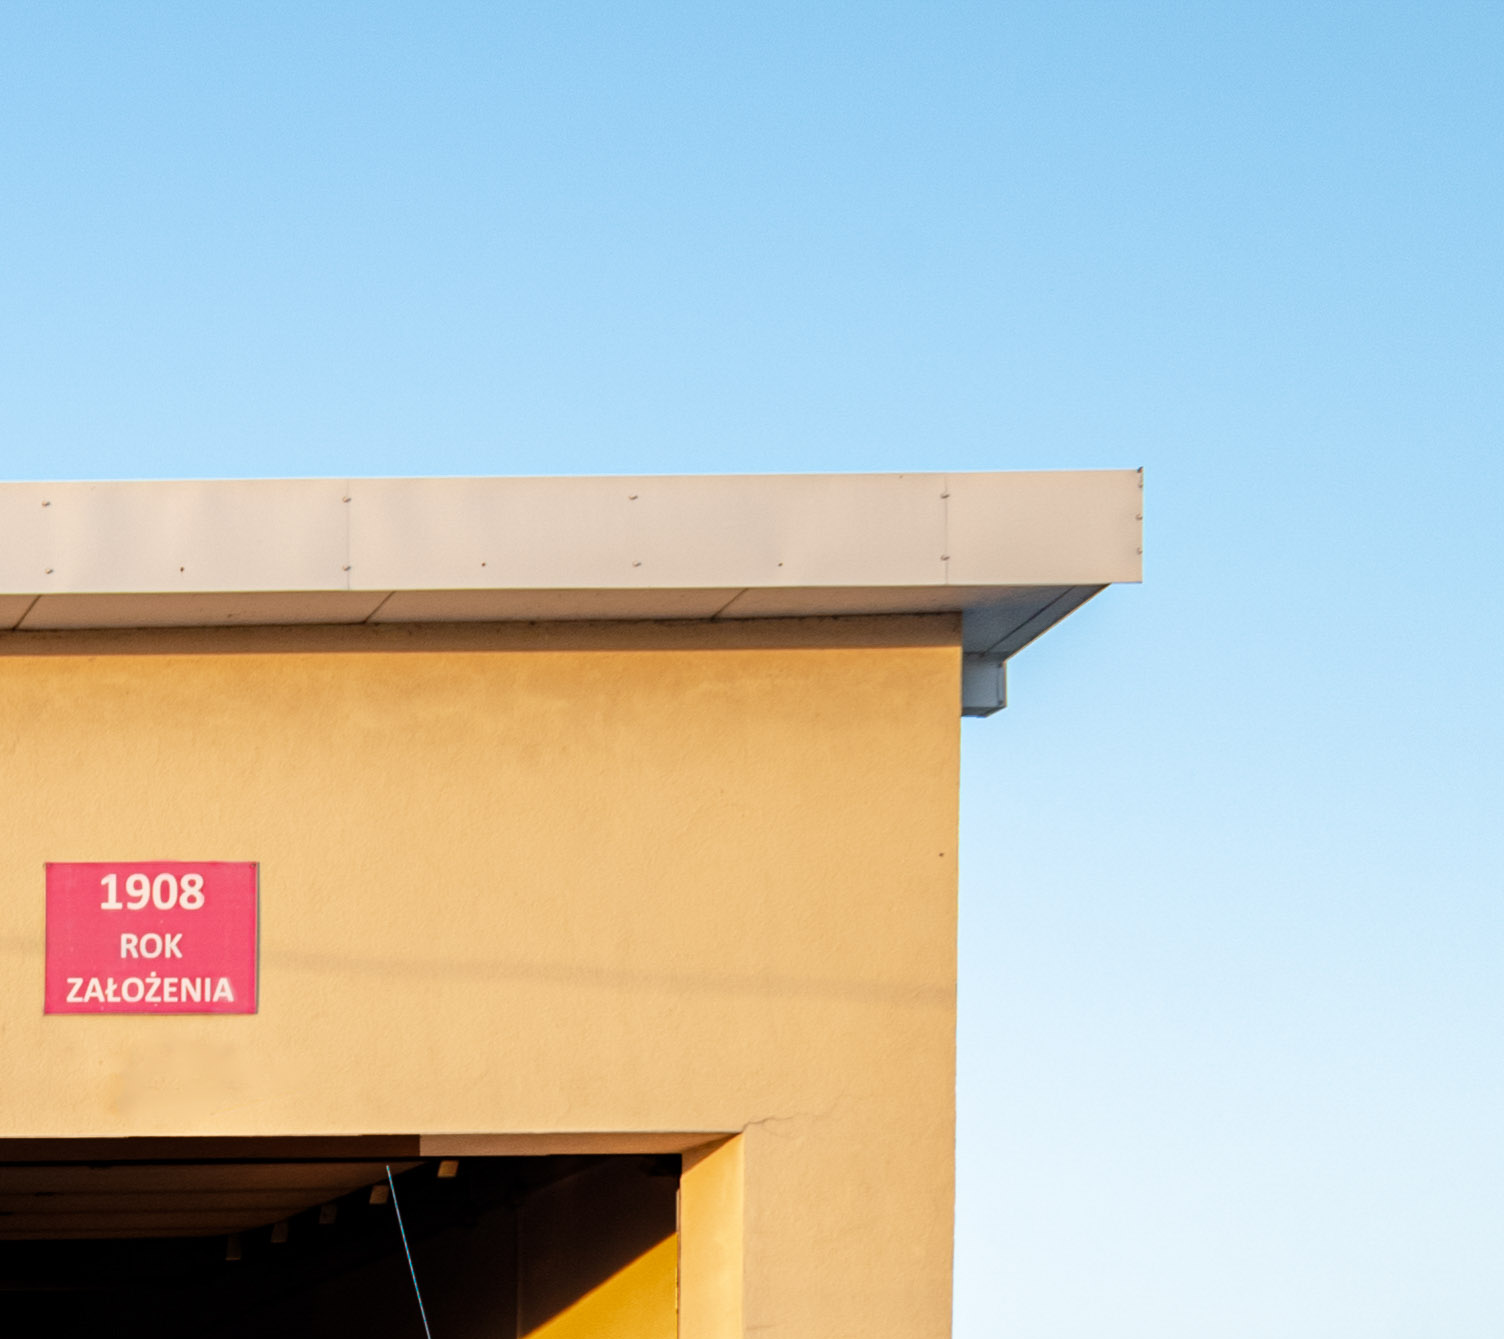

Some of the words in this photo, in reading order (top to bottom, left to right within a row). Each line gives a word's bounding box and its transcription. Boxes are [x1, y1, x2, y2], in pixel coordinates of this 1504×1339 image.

[99, 873, 206, 911] 1908
[120, 934, 183, 959] ROK
[66, 971, 235, 1003] ZAŁOŻENIA
